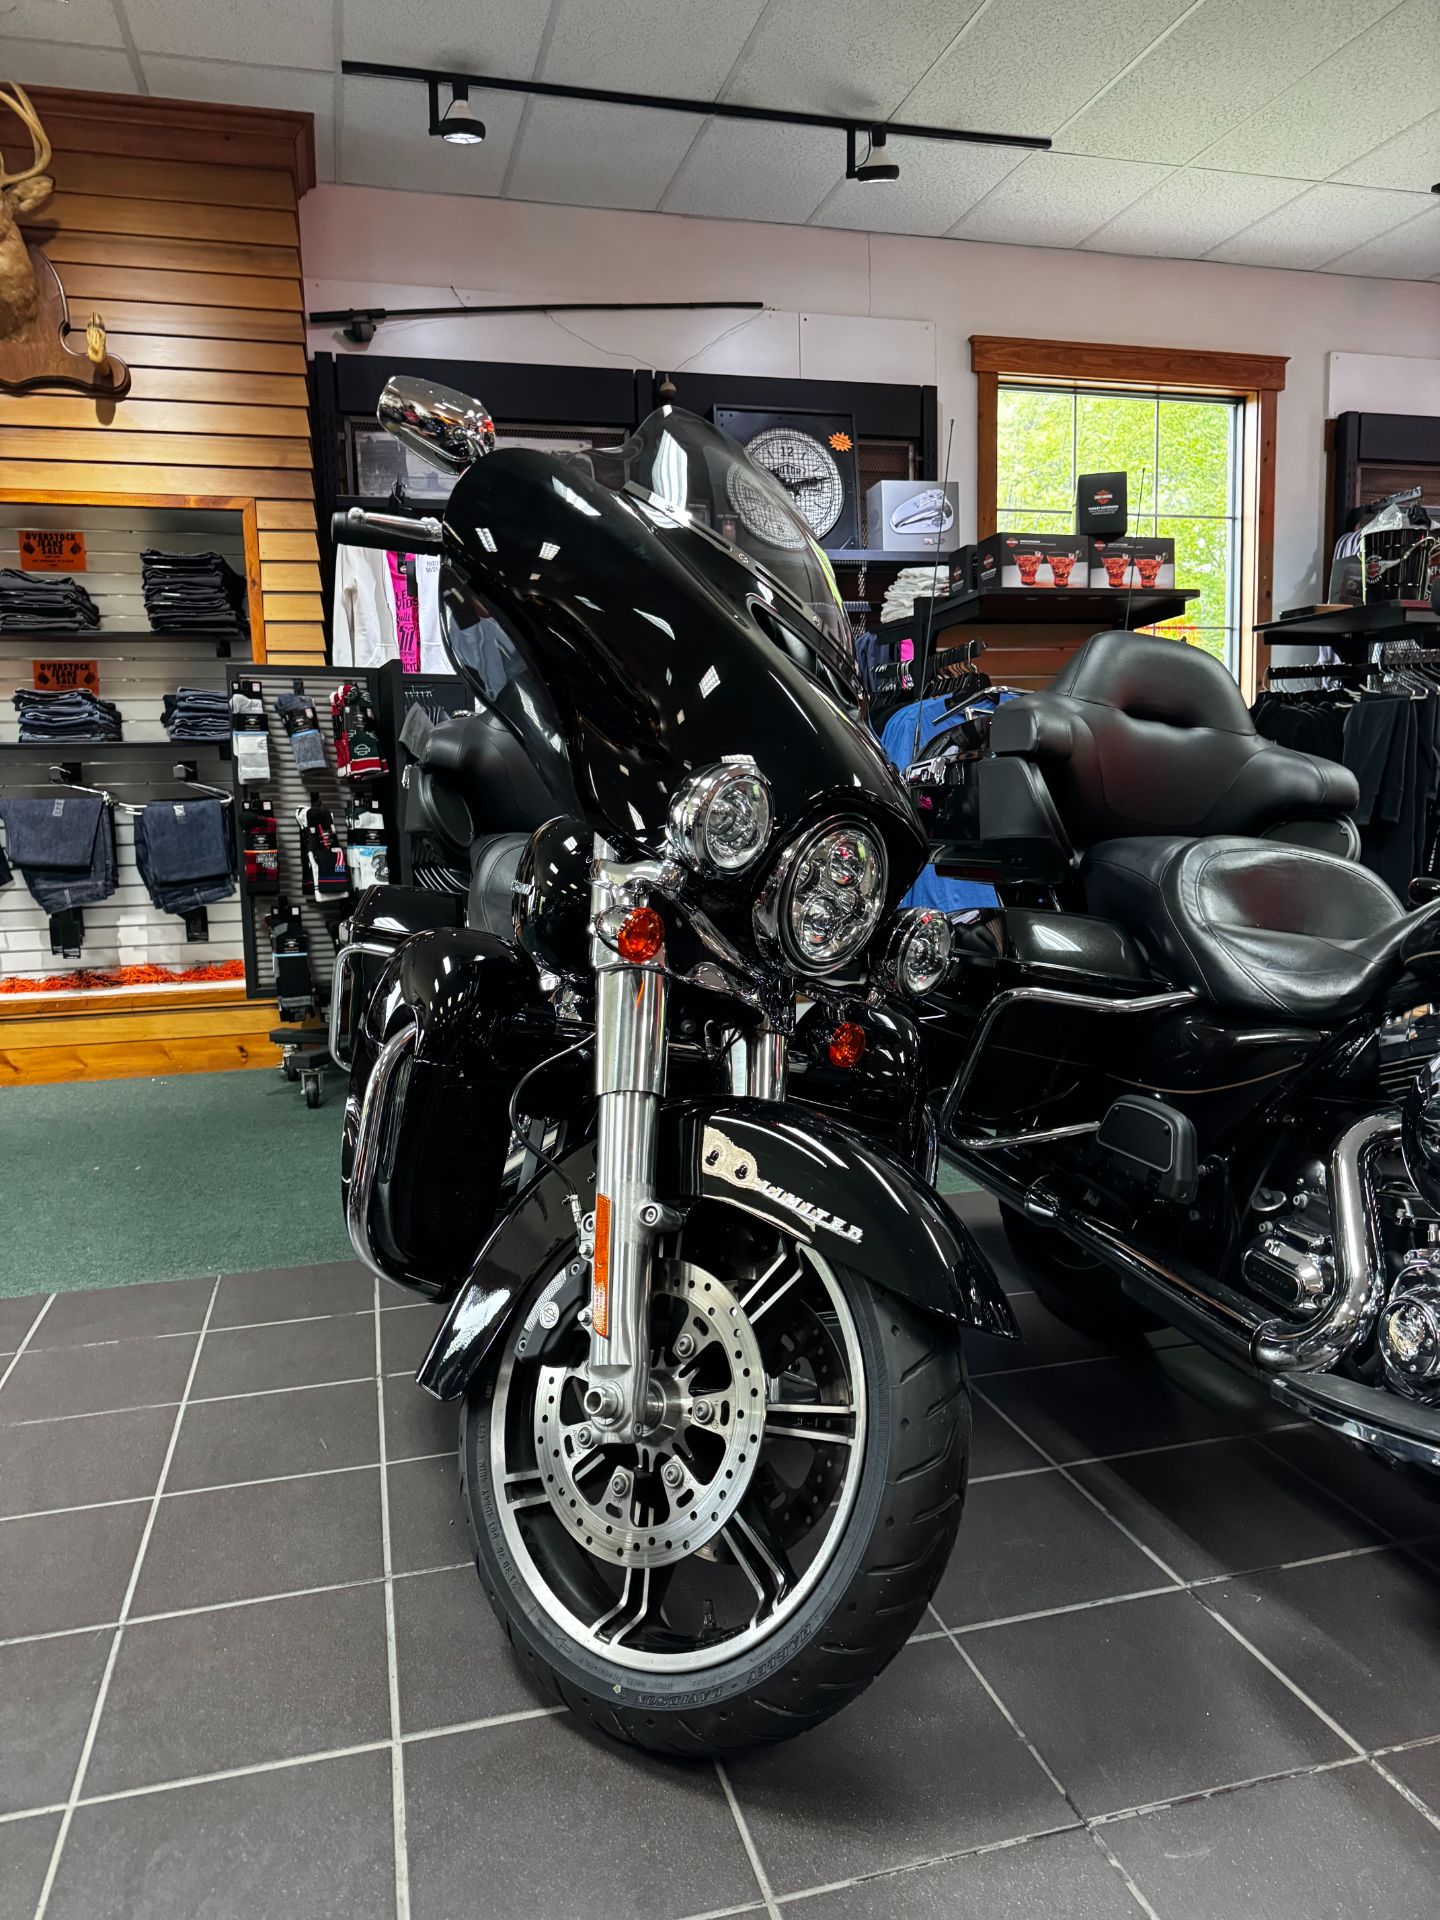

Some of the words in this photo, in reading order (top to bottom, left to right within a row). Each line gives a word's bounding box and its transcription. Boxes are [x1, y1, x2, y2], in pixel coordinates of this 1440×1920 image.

[780, 446, 794, 457] 12
[25, 532, 76, 541] OVERSTOCK
[37, 539, 63, 548] JEANS
[42, 545, 63, 555] SALE
[40, 663, 90, 671] OVERSTOCK
[52, 670, 77, 678] JEANS
[56, 674, 77, 685] SALE
[757, 1179, 863, 1244] LIMITED
[747, 1623, 812, 1684] HARLEY
[634, 1686, 724, 1706] DAVIDSON
